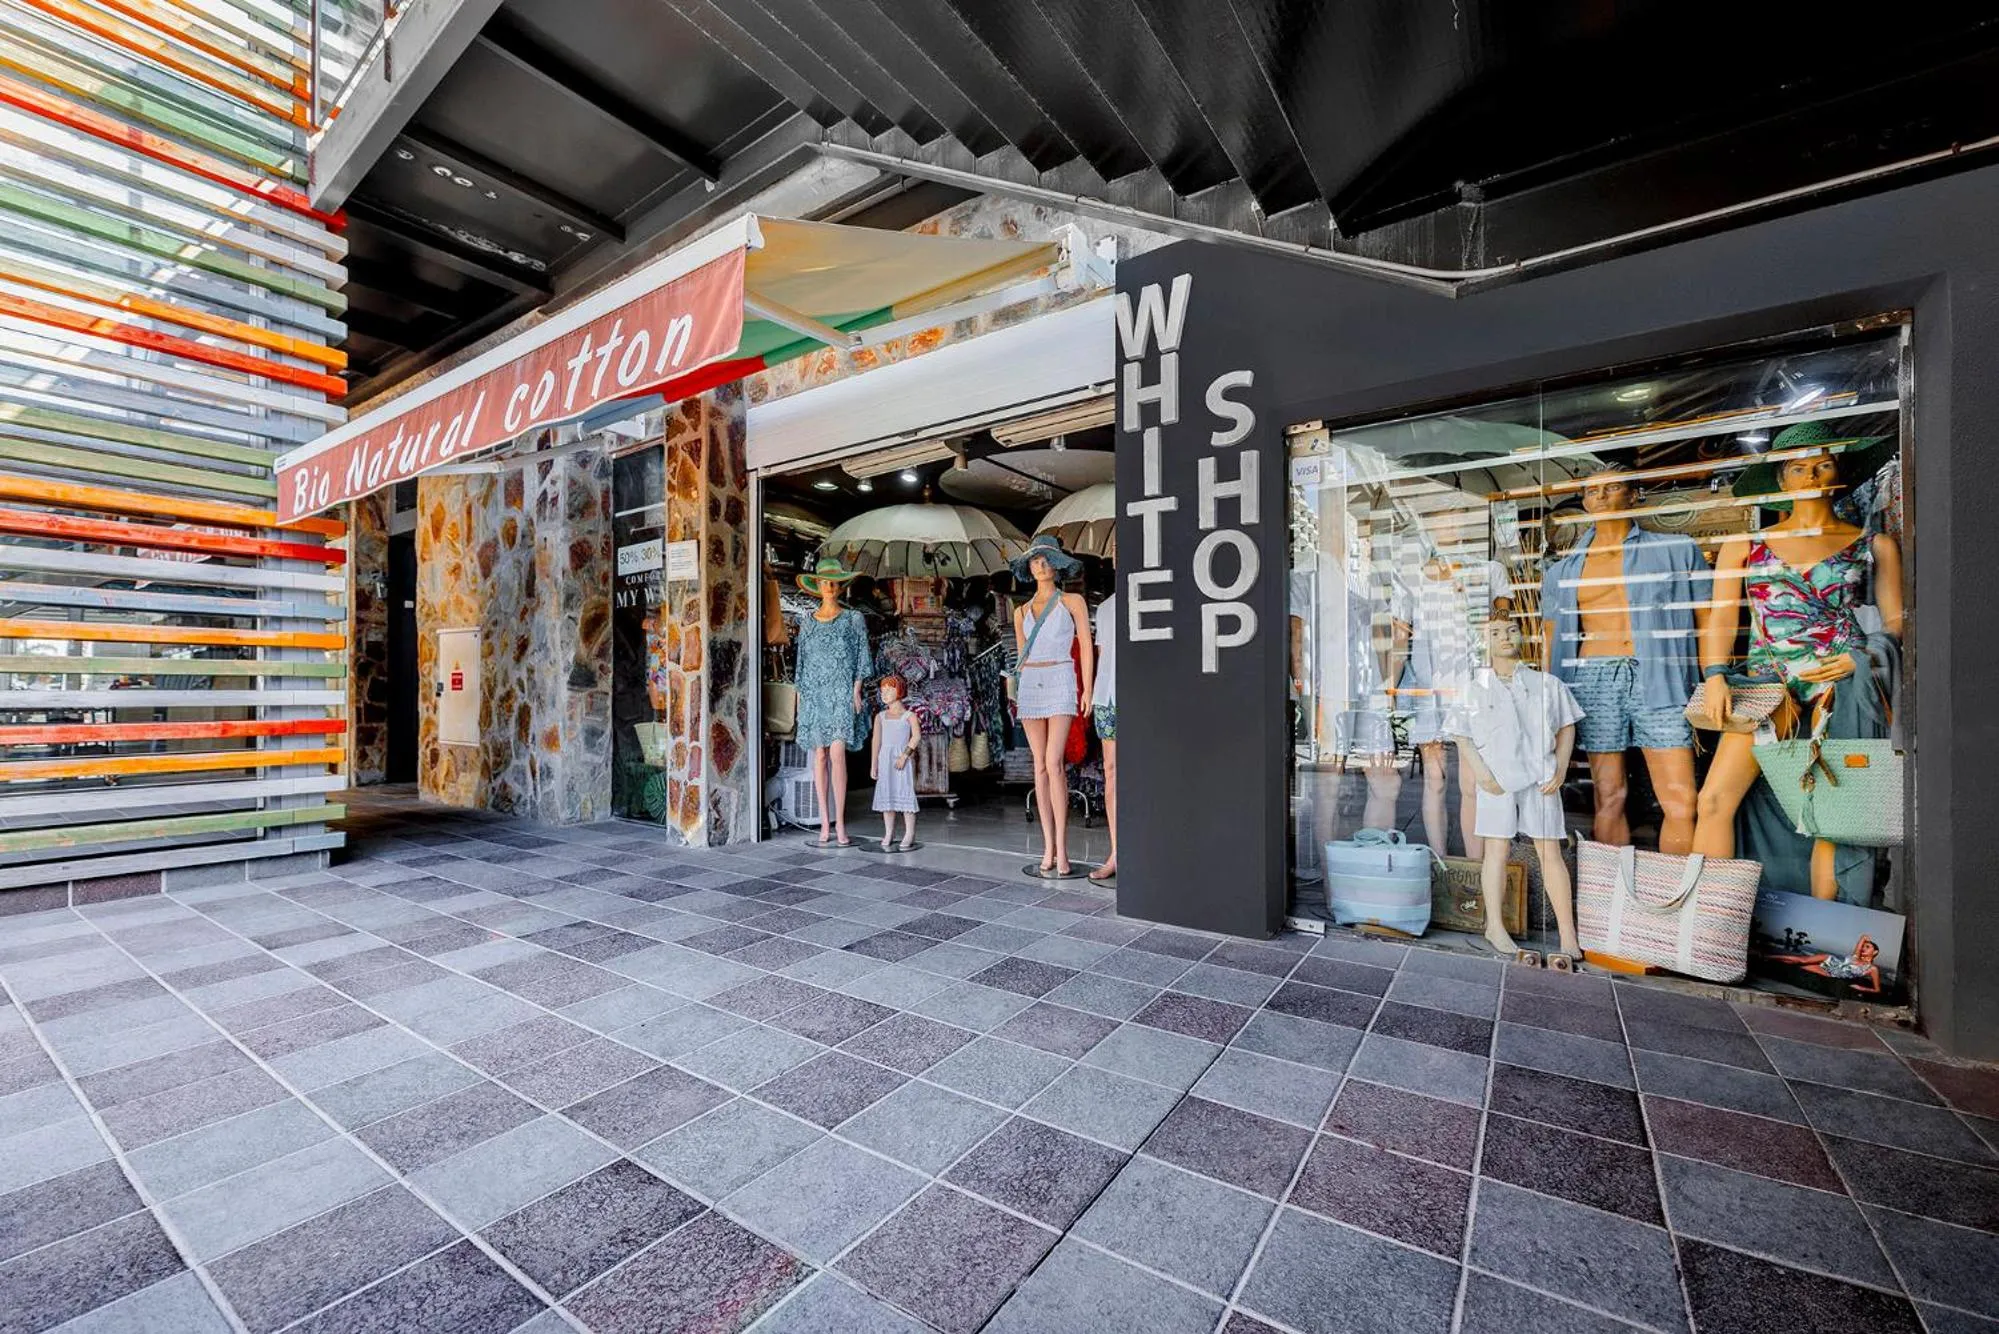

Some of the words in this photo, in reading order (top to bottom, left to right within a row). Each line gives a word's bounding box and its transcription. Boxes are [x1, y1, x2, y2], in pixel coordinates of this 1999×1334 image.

[293, 465, 330, 516] Bio
[344, 391, 486, 497] Natural
[504, 314, 693, 433] cotton
[1115, 273, 1192, 642] WHITE
[1296, 465, 1319, 476] VISA
[616, 588, 639, 608] MY
[1193, 370, 1260, 673] SHOP
